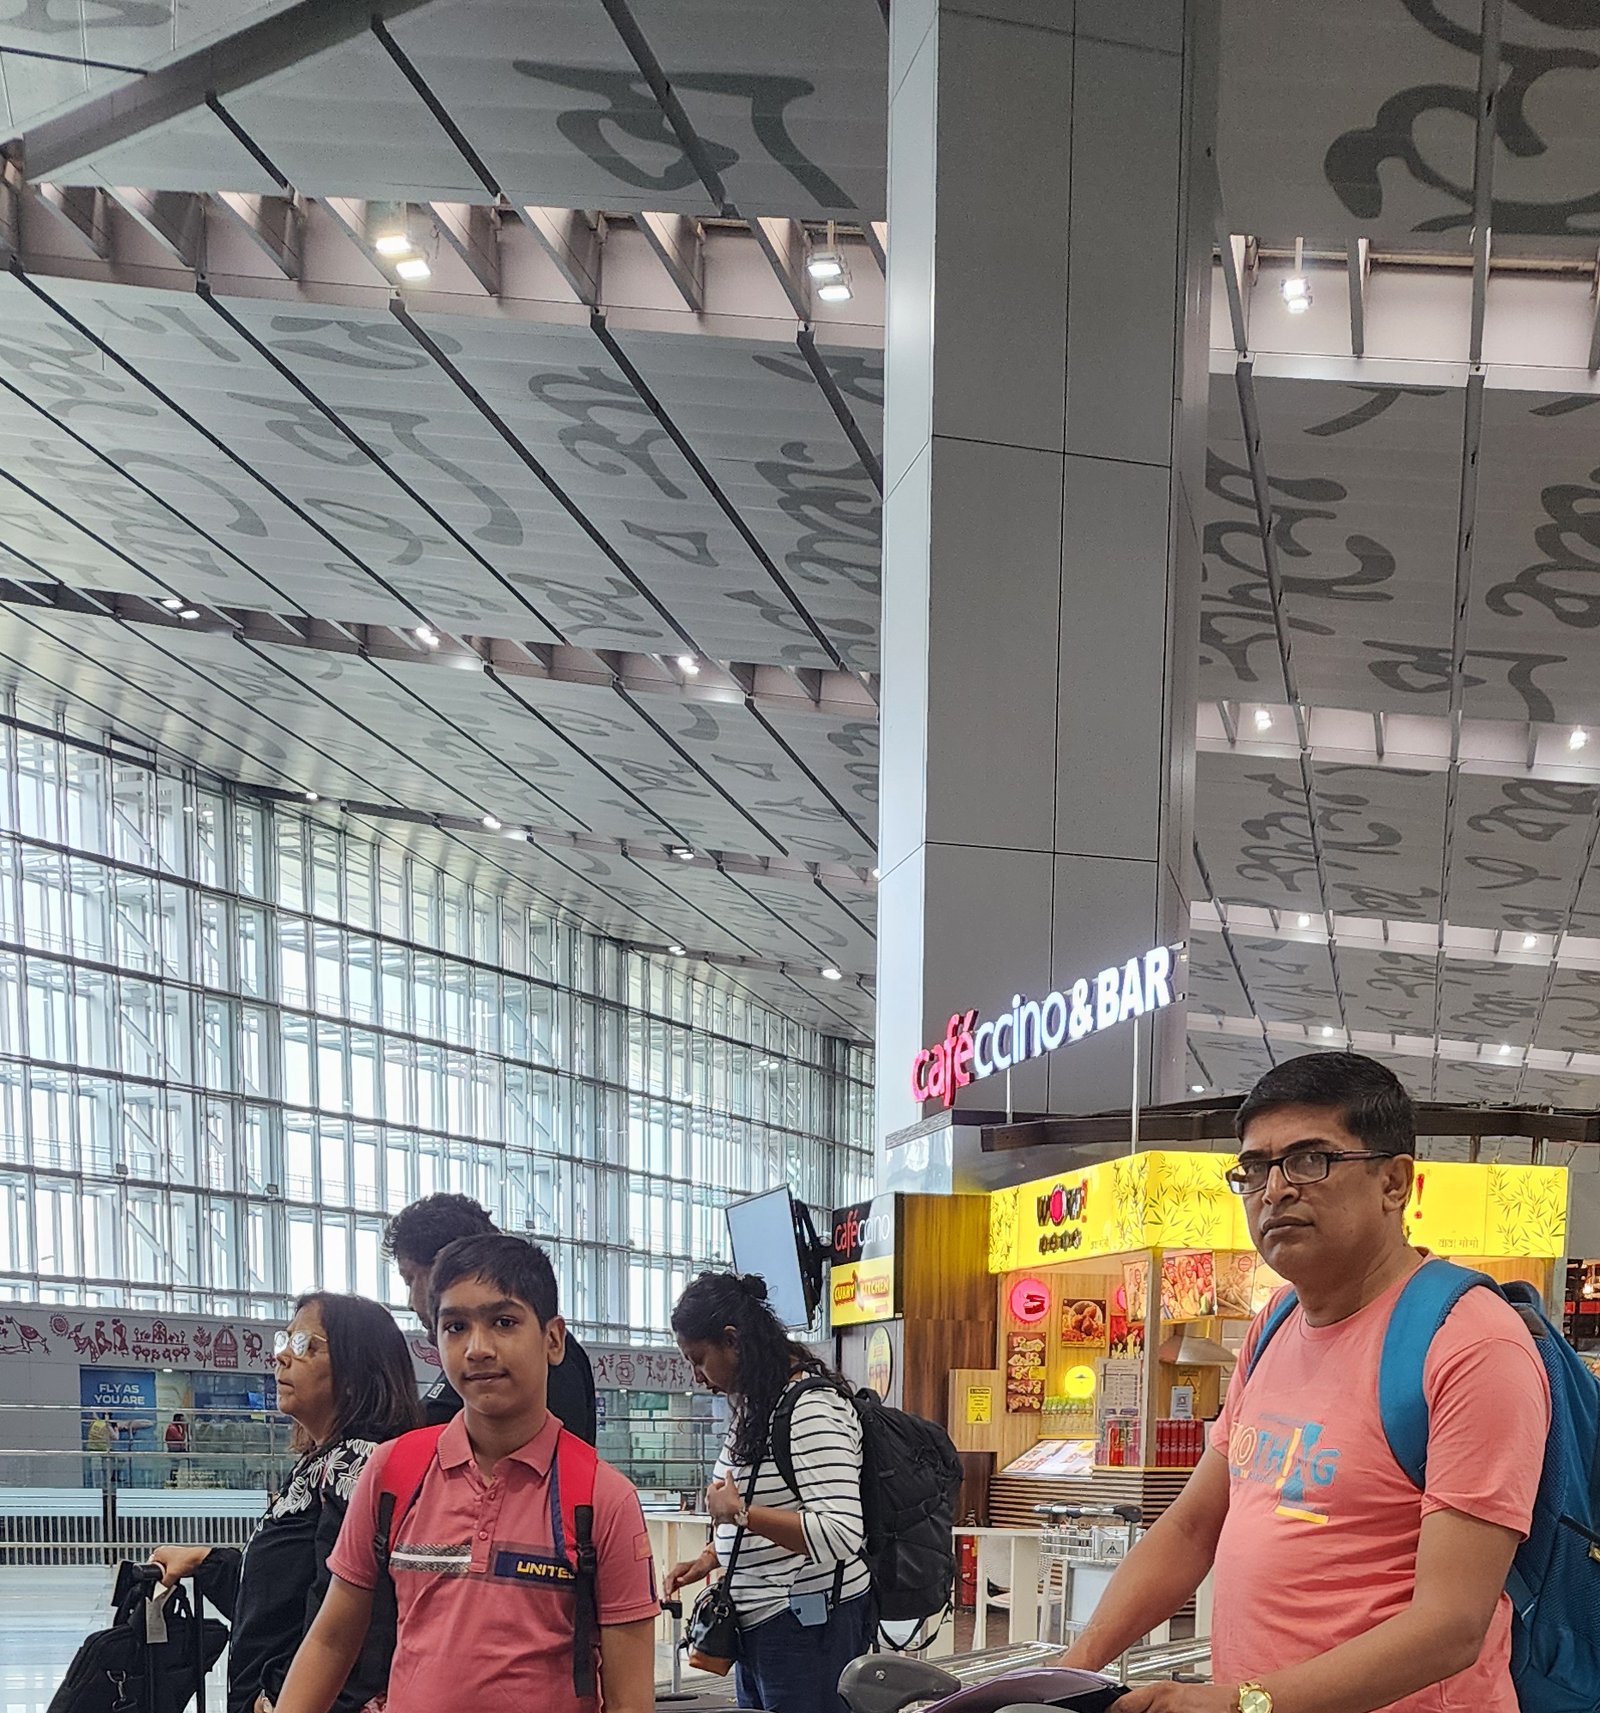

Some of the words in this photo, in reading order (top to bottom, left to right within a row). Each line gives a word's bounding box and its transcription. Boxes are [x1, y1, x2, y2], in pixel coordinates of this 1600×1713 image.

[911, 991, 1068, 1107] caféccino
[1096, 945, 1175, 1031] BAR
[99, 1383, 121, 1393] FLY
[123, 1384, 140, 1394] AS
[94, 1394, 120, 1404] YOU
[121, 1395, 145, 1405] ARE
[516, 1560, 576, 1579] UNITE
